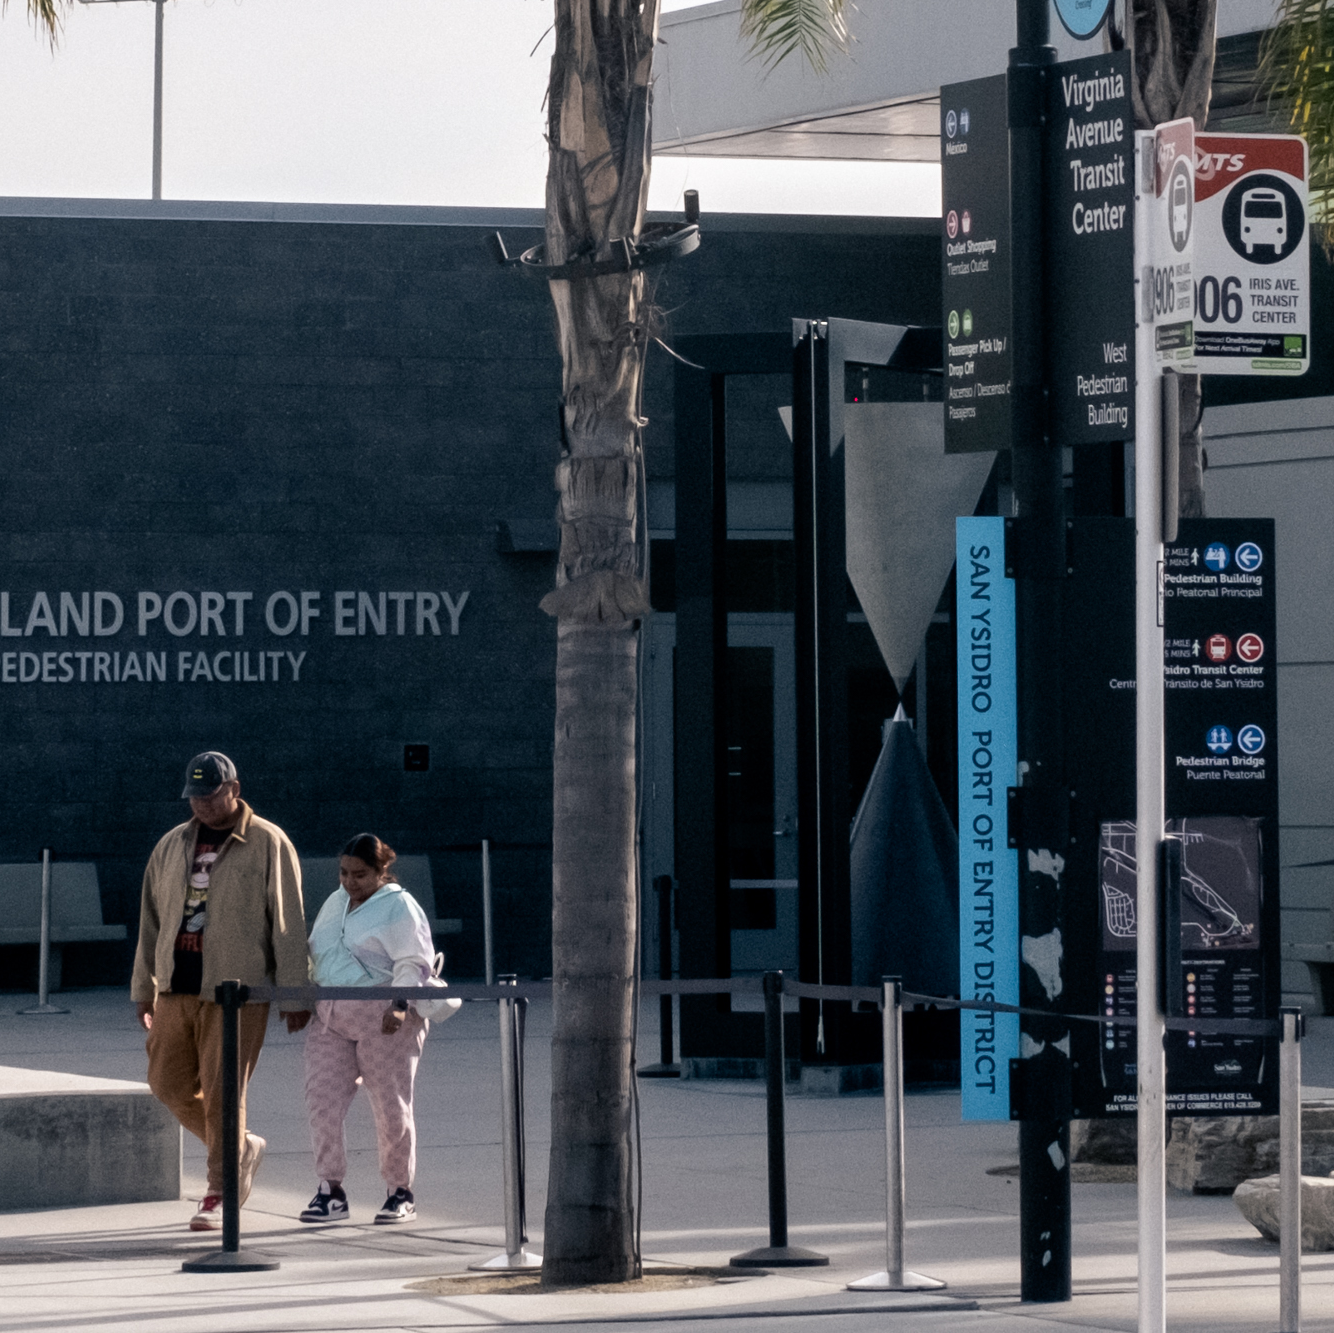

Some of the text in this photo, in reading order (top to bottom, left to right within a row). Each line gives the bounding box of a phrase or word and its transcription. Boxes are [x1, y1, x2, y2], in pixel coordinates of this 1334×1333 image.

[1062, 67, 1125, 112] Virginia
[1065, 117, 1124, 150] Avenue
[1070, 153, 1125, 192] Transit
[1072, 201, 1126, 235] Center
[947, 238, 997, 257] Outlet Shopping
[947, 259, 989, 276] Tiendas Outlet
[1249, 278, 1300, 292] IRIS AVE.
[1194, 275, 1243, 324] 06
[1250, 294, 1299, 307] TRANSIT
[1252, 311, 1296, 324] CENTER
[948, 343, 978, 358] Passenger
[979, 338, 993, 353] Pick
[993, 338, 1003, 354] Up
[1103, 342, 1127, 363] West
[948, 361, 975, 378] Drop Off
[1077, 372, 1127, 396] Pedestrian
[1088, 402, 1128, 428] Building
[1171, 548, 1189, 556] MILE
[1169, 558, 1190, 566] MINS
[1164, 573, 1263, 585] Pedestrian Building
[1176, 587, 1219, 597] Peatonal
[1221, 587, 1263, 598] Principal
[0, 591, 124, 637] LAND
[137, 591, 253, 637] PORT
[266, 591, 321, 637] OF
[334, 591, 471, 636] ENTRY
[1172, 639, 1191, 647] MILE
[1170, 649, 1191, 657] MINS
[177, 651, 307, 682] FACILITY
[1192, 665, 1227, 674] Transit
[1229, 665, 1264, 674] Center
[1109, 679, 1137, 689] Centr
[1200, 679, 1213, 688] de
[1215, 679, 1232, 688] San
[1234, 679, 1264, 689] Ysidro
[1176, 756, 1265, 767] Pedestrian Bridge
[1186, 769, 1265, 779] Puente Peatonal
[970, 545, 996, 1094] SAN YSIDRO PORT OF ENTRY DISTRICT
